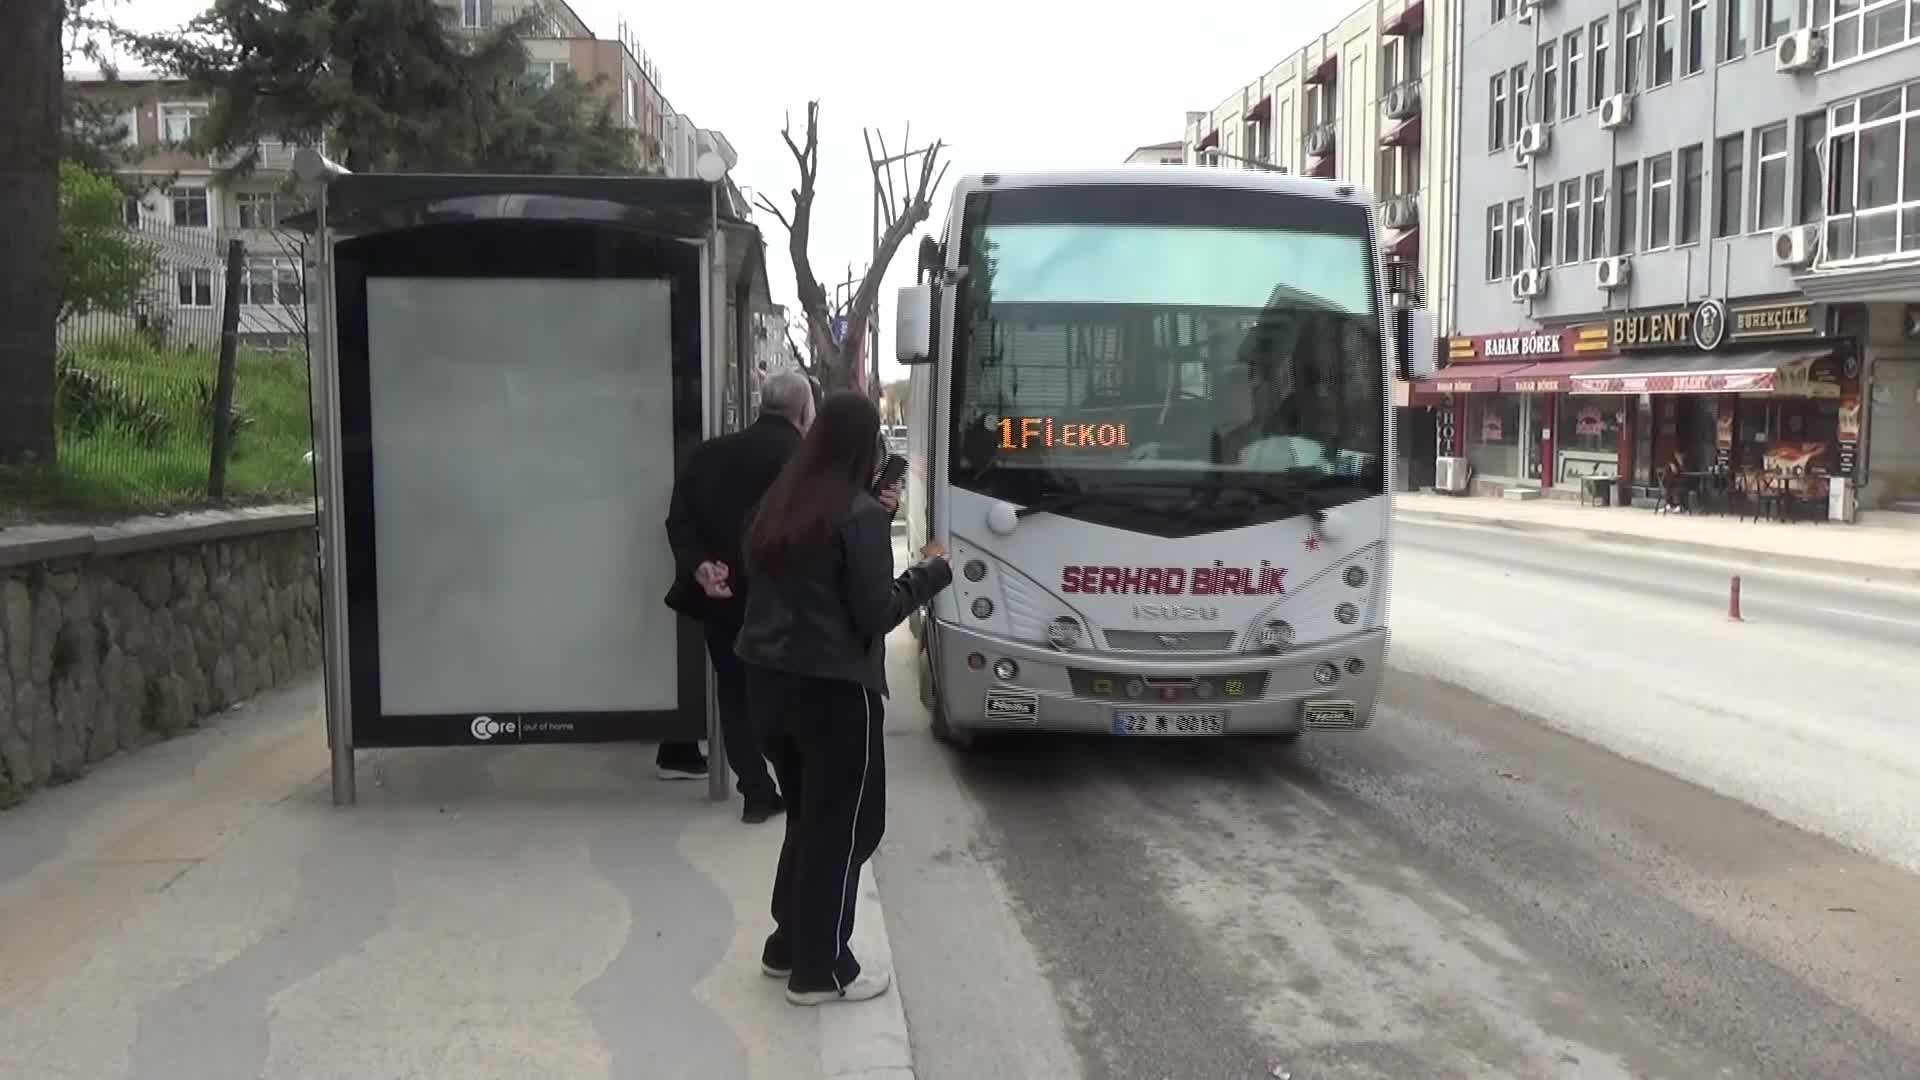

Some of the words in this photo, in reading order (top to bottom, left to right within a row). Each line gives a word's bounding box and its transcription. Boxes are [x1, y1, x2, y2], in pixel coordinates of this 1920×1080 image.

[1613, 312, 1691, 344] BÜLENT
[1484, 338, 1519, 356] BAHAR
[1521, 331, 1560, 355] BÖREK
[1061, 566, 1186, 595] SERHAD
[1191, 559, 1288, 596] BİRLİK
[1132, 601, 1220, 621] ISUZU
[523, 722, 537, 731] out
[539, 722, 548, 731] of
[1124, 714, 1148, 732] 22
[1175, 714, 1221, 732] 0015
